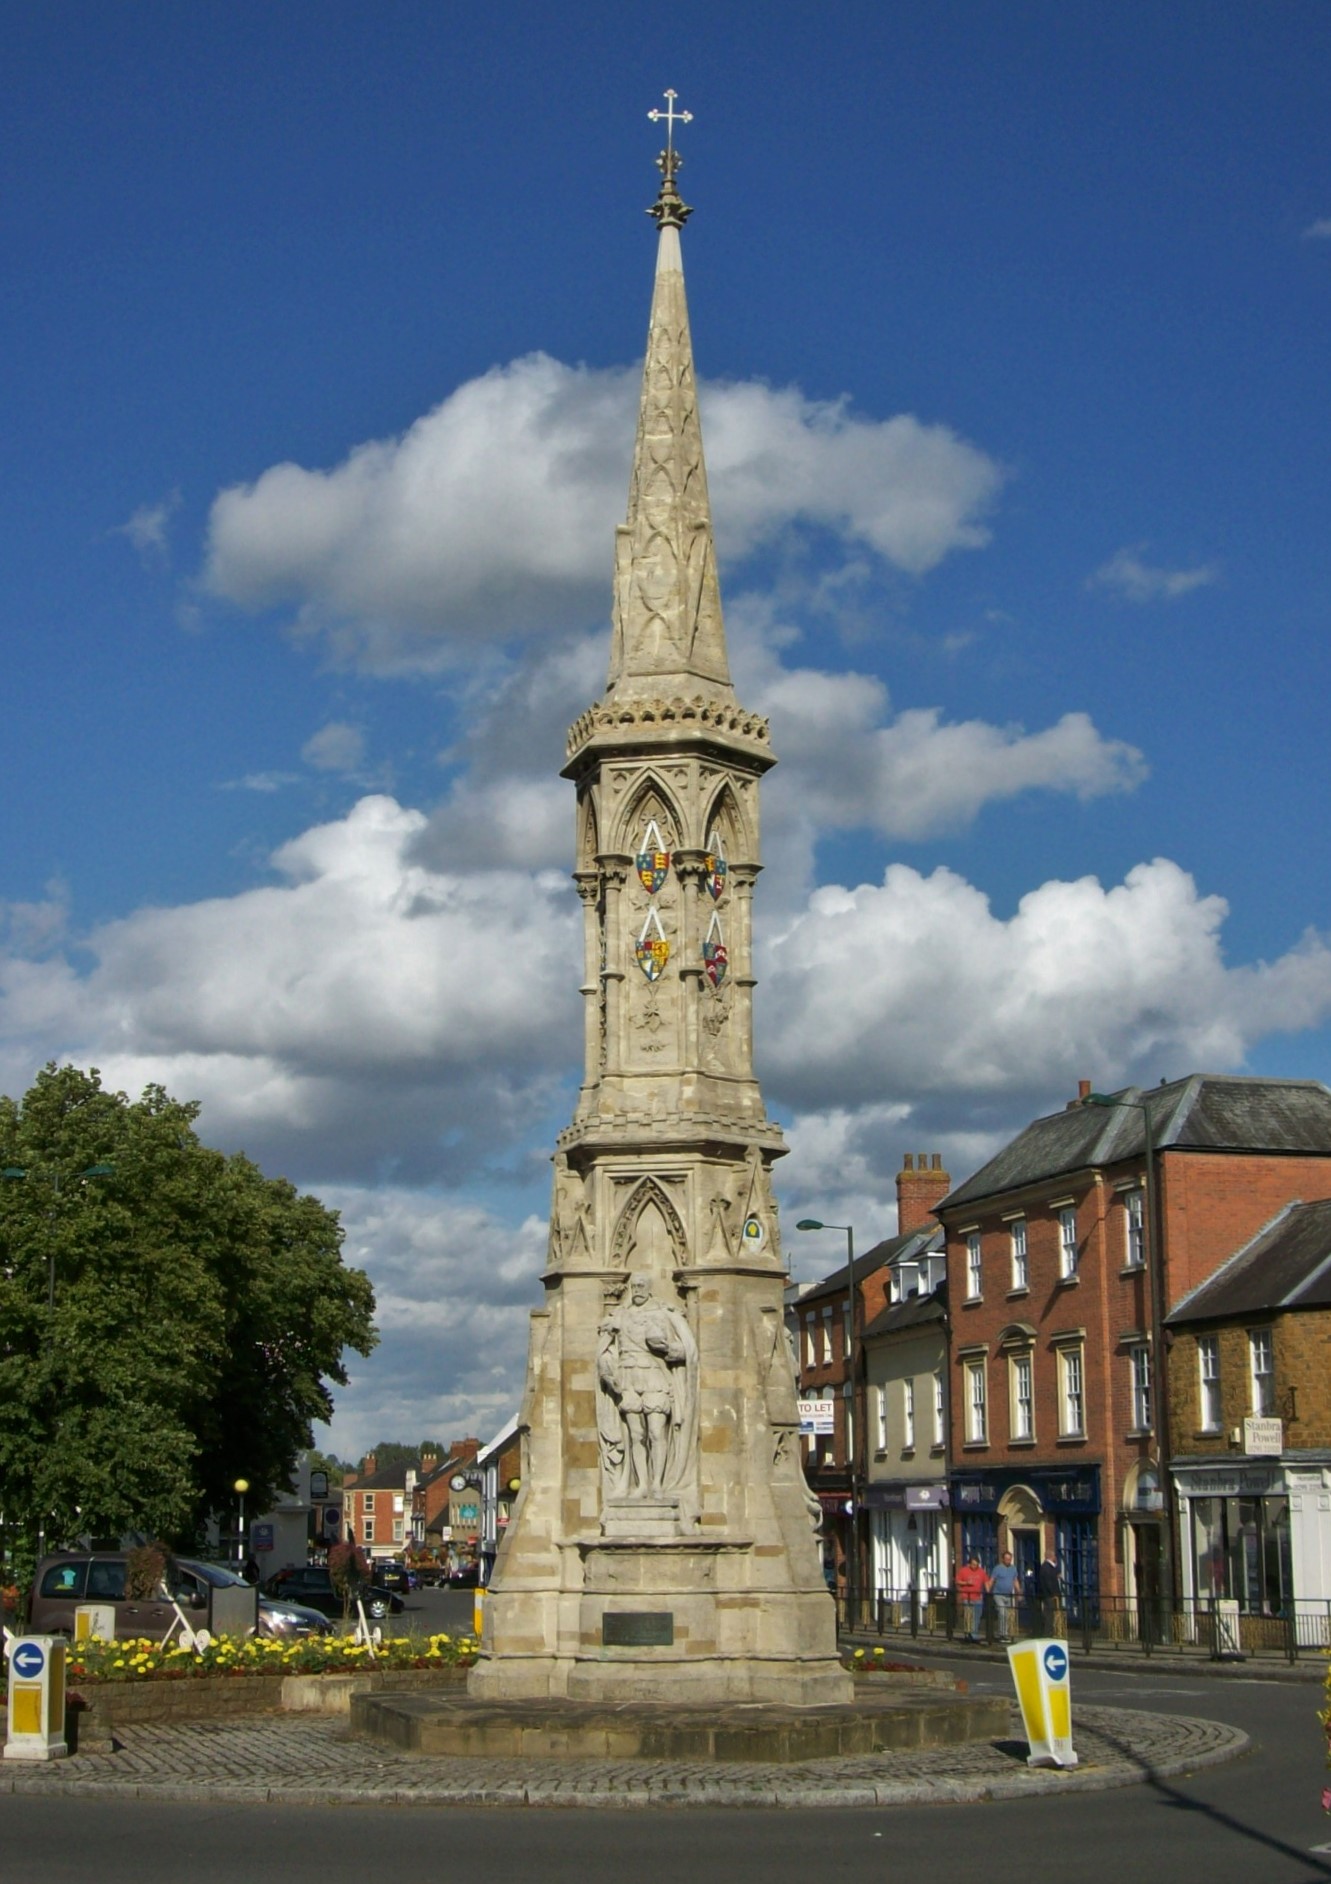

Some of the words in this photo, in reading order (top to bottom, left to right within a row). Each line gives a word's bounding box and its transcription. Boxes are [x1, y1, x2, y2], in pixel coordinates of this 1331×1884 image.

[799, 1403, 812, 1412] TO
[814, 1403, 832, 1412] LET
[1245, 1420, 1281, 1431] Stanbra
[1252, 1431, 1281, 1443] Powell
[1190, 1472, 1236, 1492] Stanbra
[1239, 1470, 1276, 1490] Powell
